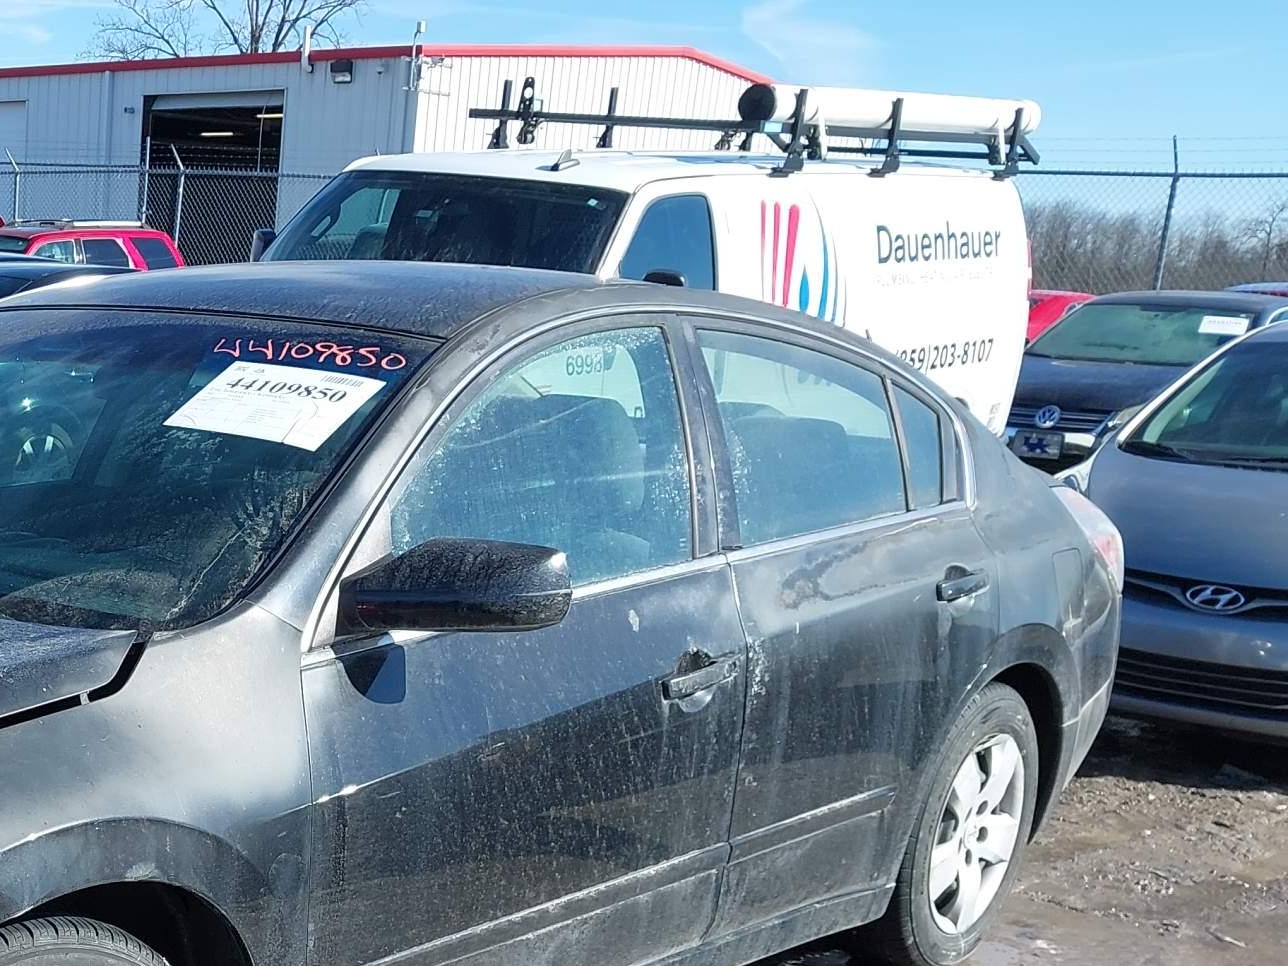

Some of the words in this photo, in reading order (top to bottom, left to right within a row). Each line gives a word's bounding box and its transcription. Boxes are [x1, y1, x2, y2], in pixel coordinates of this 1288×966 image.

[876, 219, 1001, 265] Dauenhauer
[213, 337, 408, 371] 44109850
[226, 376, 348, 403] 44109850
